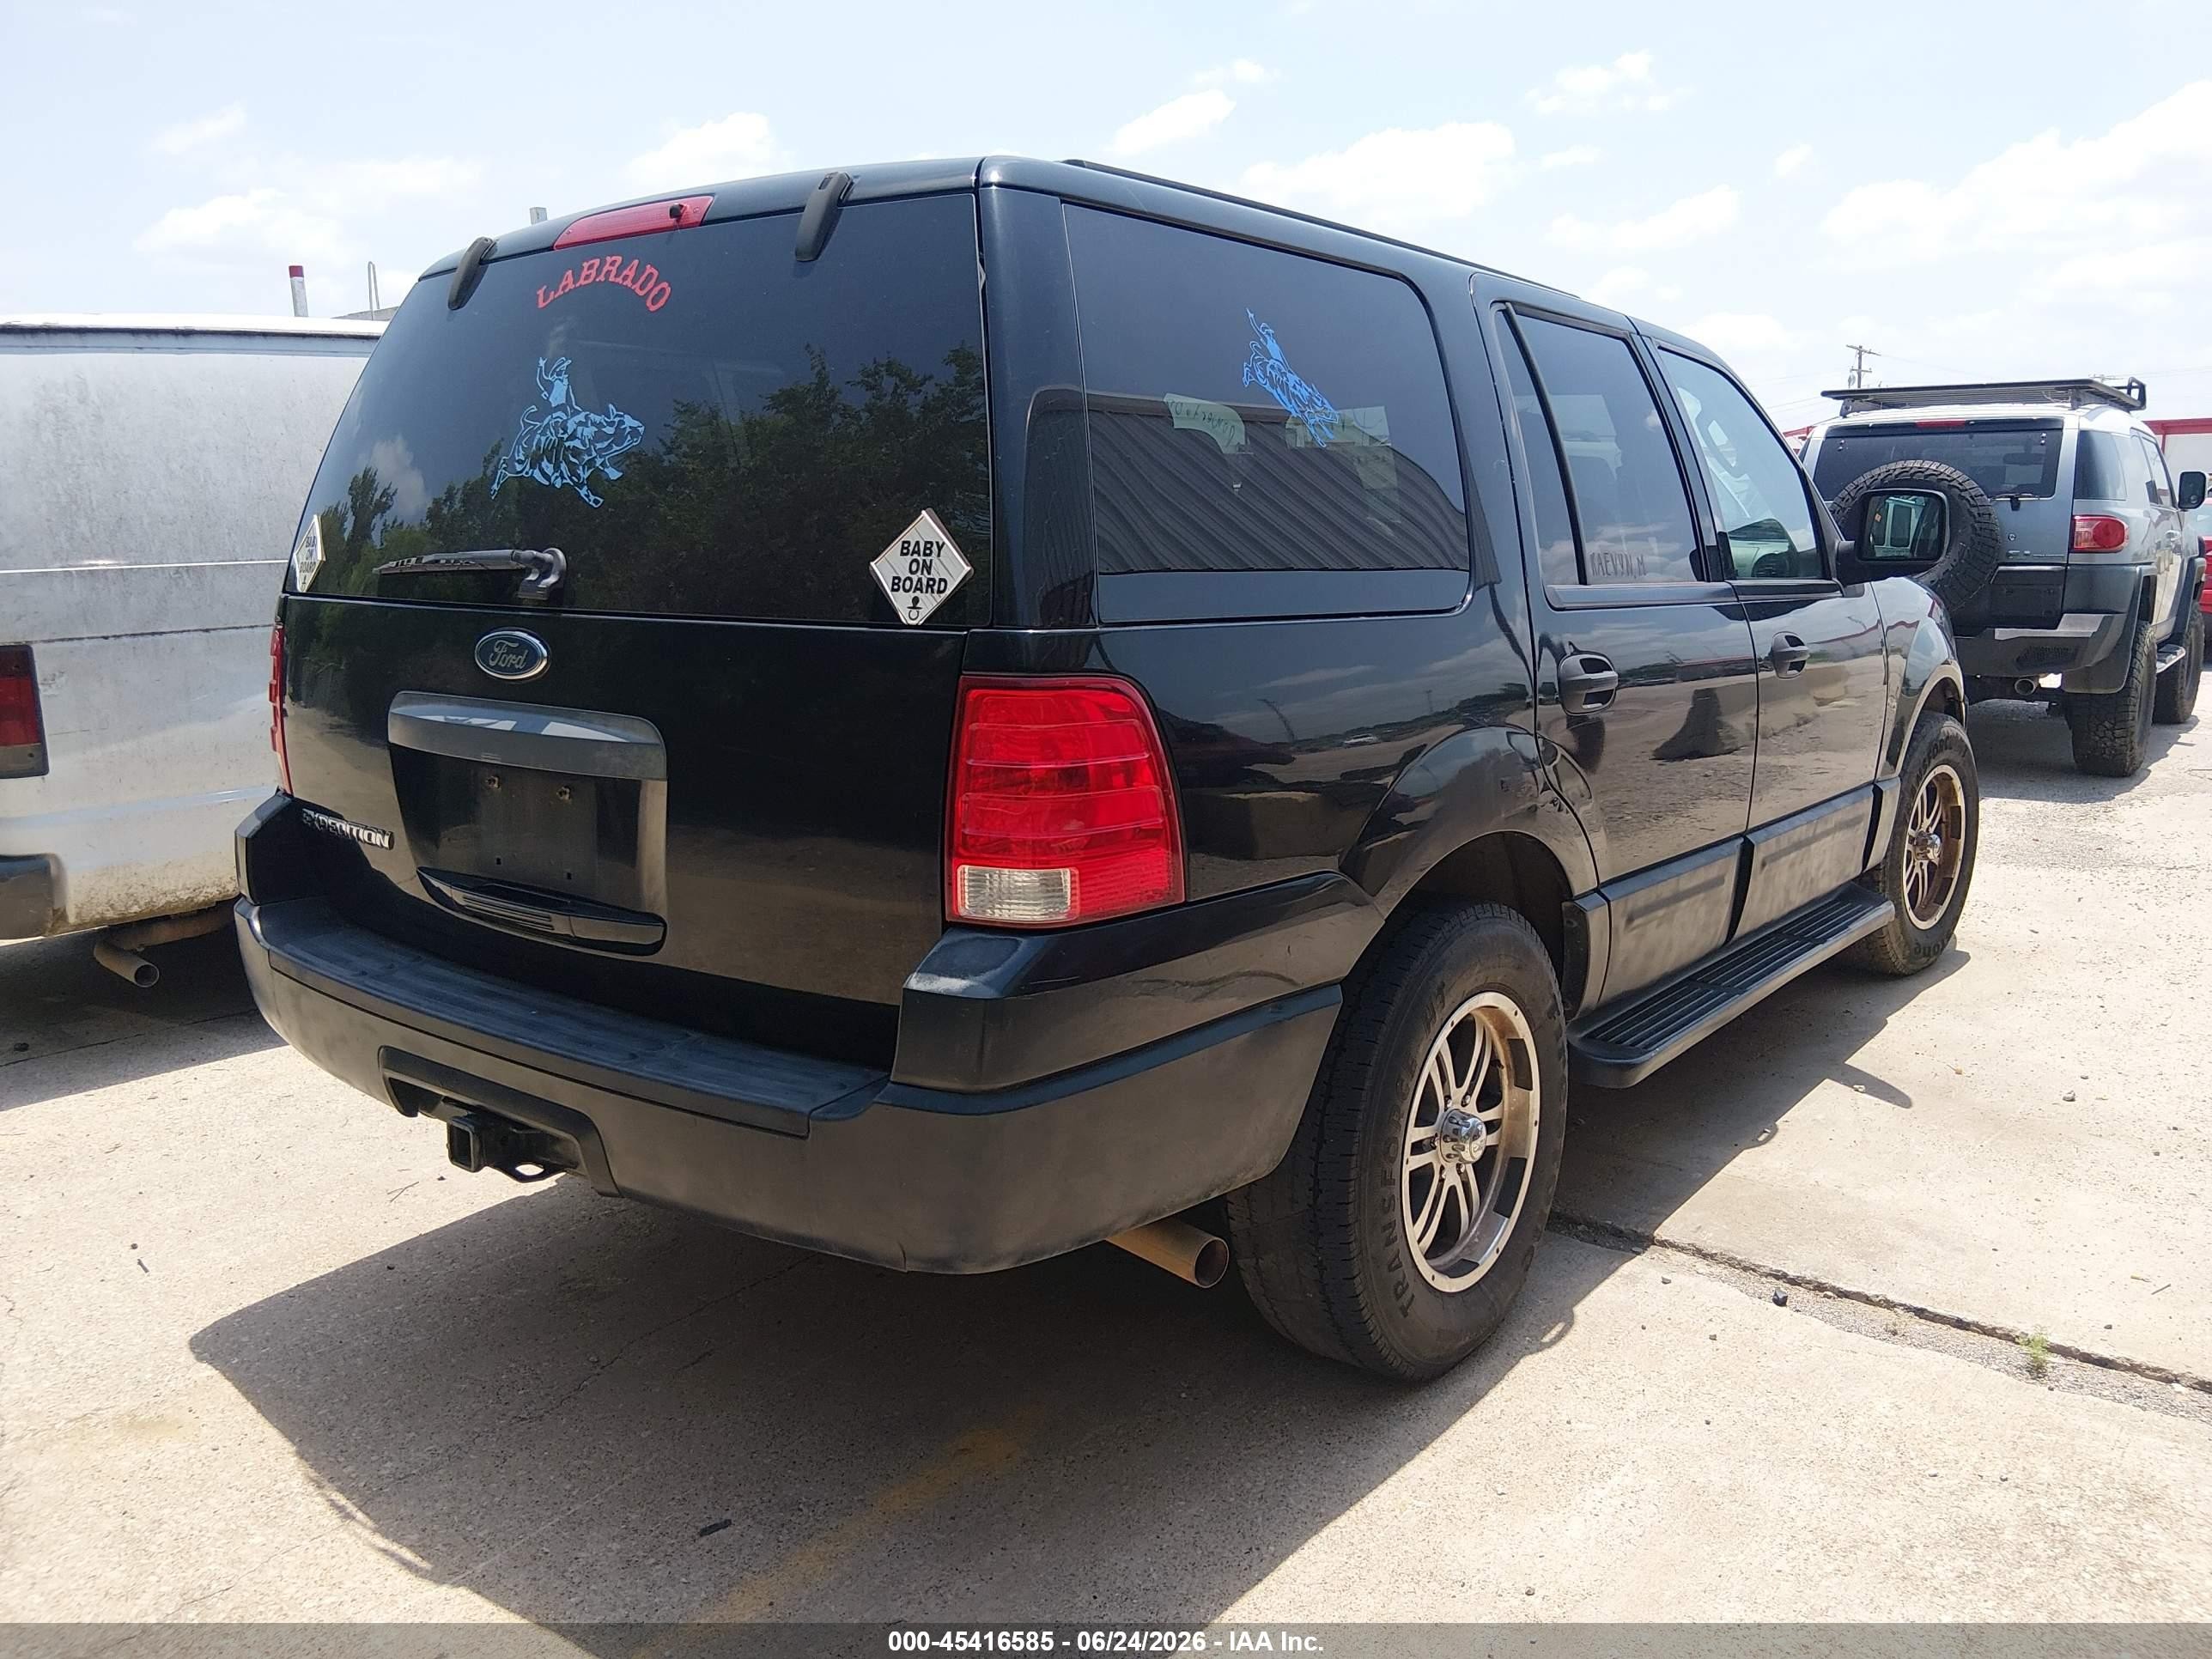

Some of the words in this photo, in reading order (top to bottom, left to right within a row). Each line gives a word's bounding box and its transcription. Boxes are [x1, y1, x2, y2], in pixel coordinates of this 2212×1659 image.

[536, 255, 672, 313] LABRADO
[899, 539, 946, 558] BABY
[908, 557, 933, 576] ON
[890, 575, 948, 595] BOARD
[489, 640, 529, 670] Ford
